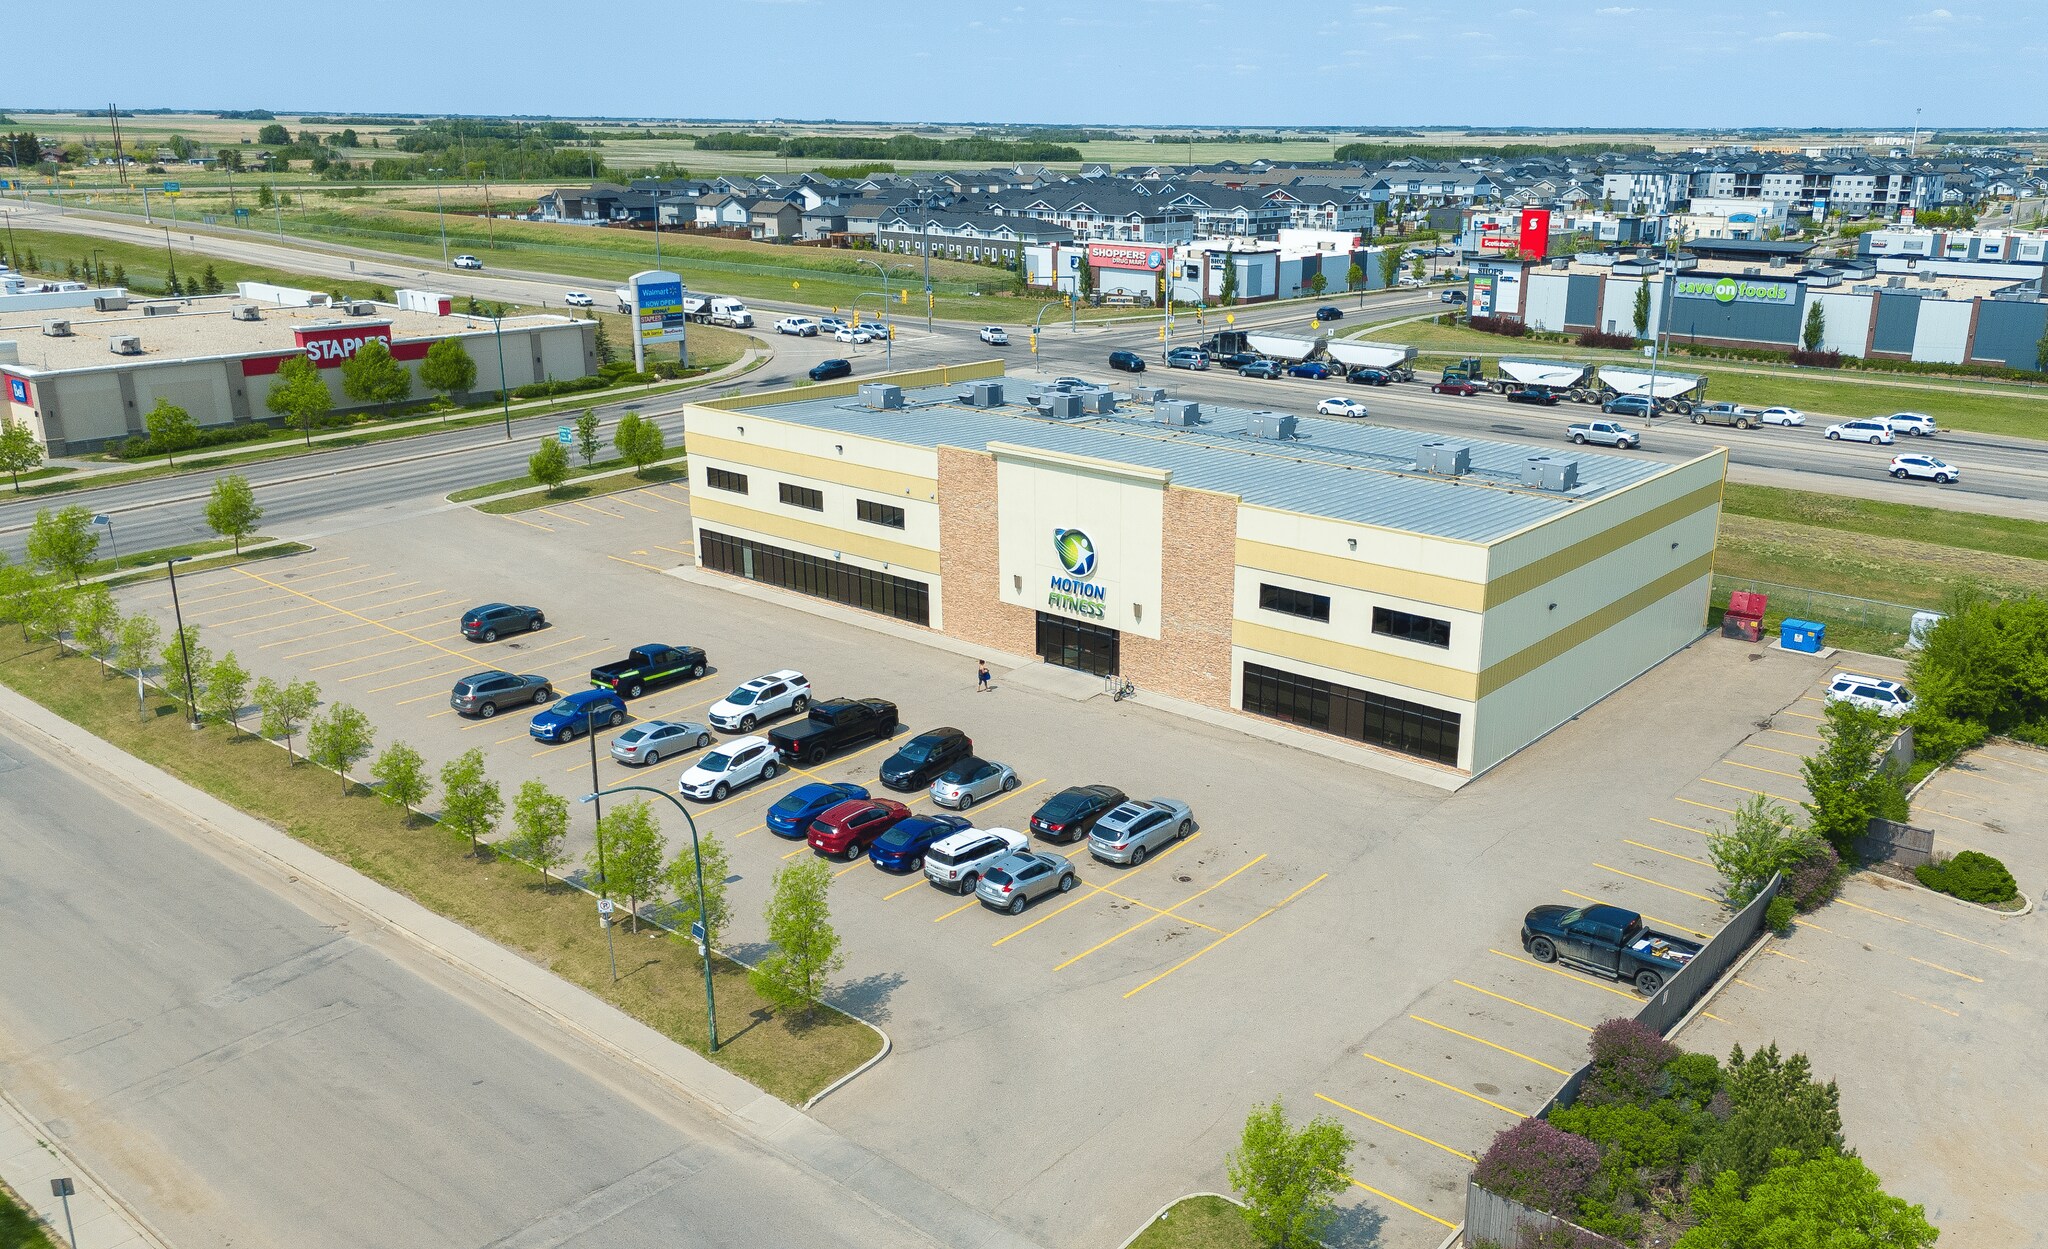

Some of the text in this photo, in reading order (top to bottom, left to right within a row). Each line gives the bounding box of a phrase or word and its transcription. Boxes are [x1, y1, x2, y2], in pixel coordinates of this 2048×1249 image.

[1092, 248, 1146, 260] SHOPPERS
[642, 288, 669, 297] Walmart
[1678, 281, 1787, 299] save on foods
[1050, 575, 1105, 600] MOTION
[1048, 592, 1105, 618] FITNESS
